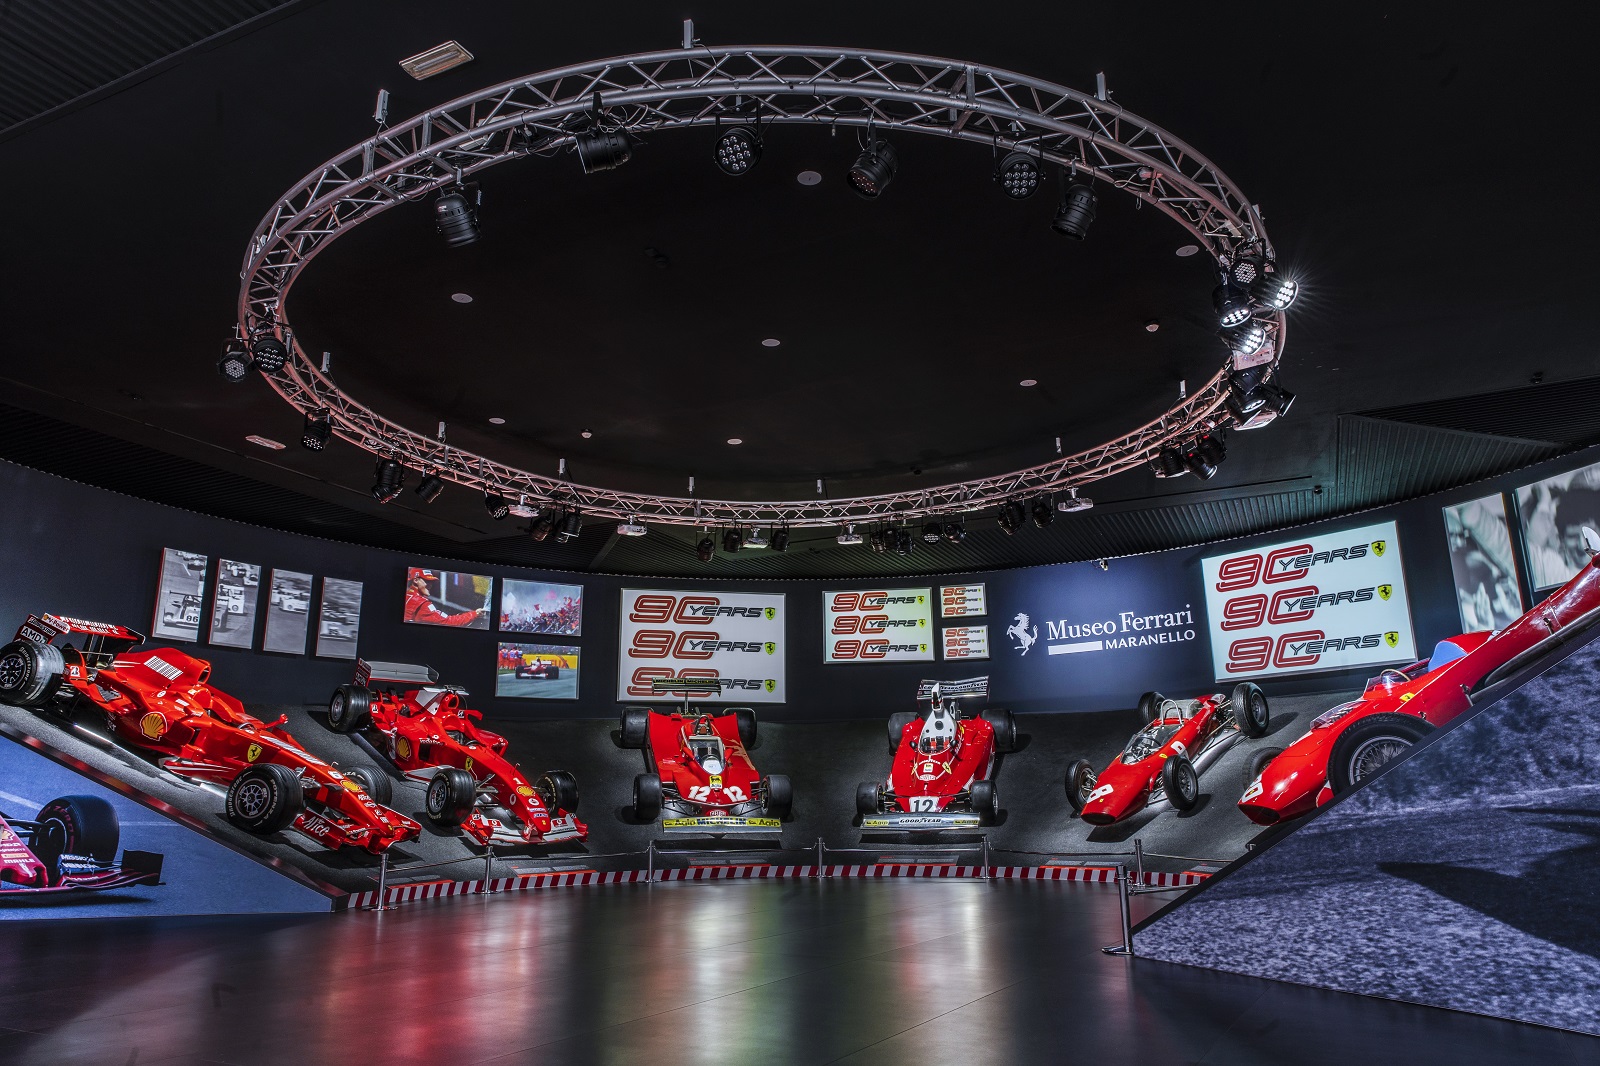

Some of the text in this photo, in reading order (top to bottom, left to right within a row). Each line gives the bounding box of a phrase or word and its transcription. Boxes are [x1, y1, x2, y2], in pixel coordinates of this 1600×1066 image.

[1216, 544, 1369, 592] 90 YEARS
[629, 594, 763, 625] 90 YEARS
[831, 592, 916, 612] 90 YEARS
[1220, 585, 1375, 631] 90 YEARS
[831, 615, 917, 634] 90 YEARS
[1046, 604, 1194, 641] Museo Ferrari
[22, 627, 42, 642] AMD
[628, 629, 763, 660] 90 YEARS
[1105, 629, 1196, 650] MARANELLO
[832, 639, 918, 659] 90 YEARS
[1225, 629, 1382, 673] 90 YEARS
[264, 779, 278, 820] POTENZA
[687, 786, 711, 802] 12
[723, 786, 748, 803] 12
[913, 799, 934, 813] 12
[697, 817, 746, 825] MICHELIN
[758, 819, 780, 827] Agip
